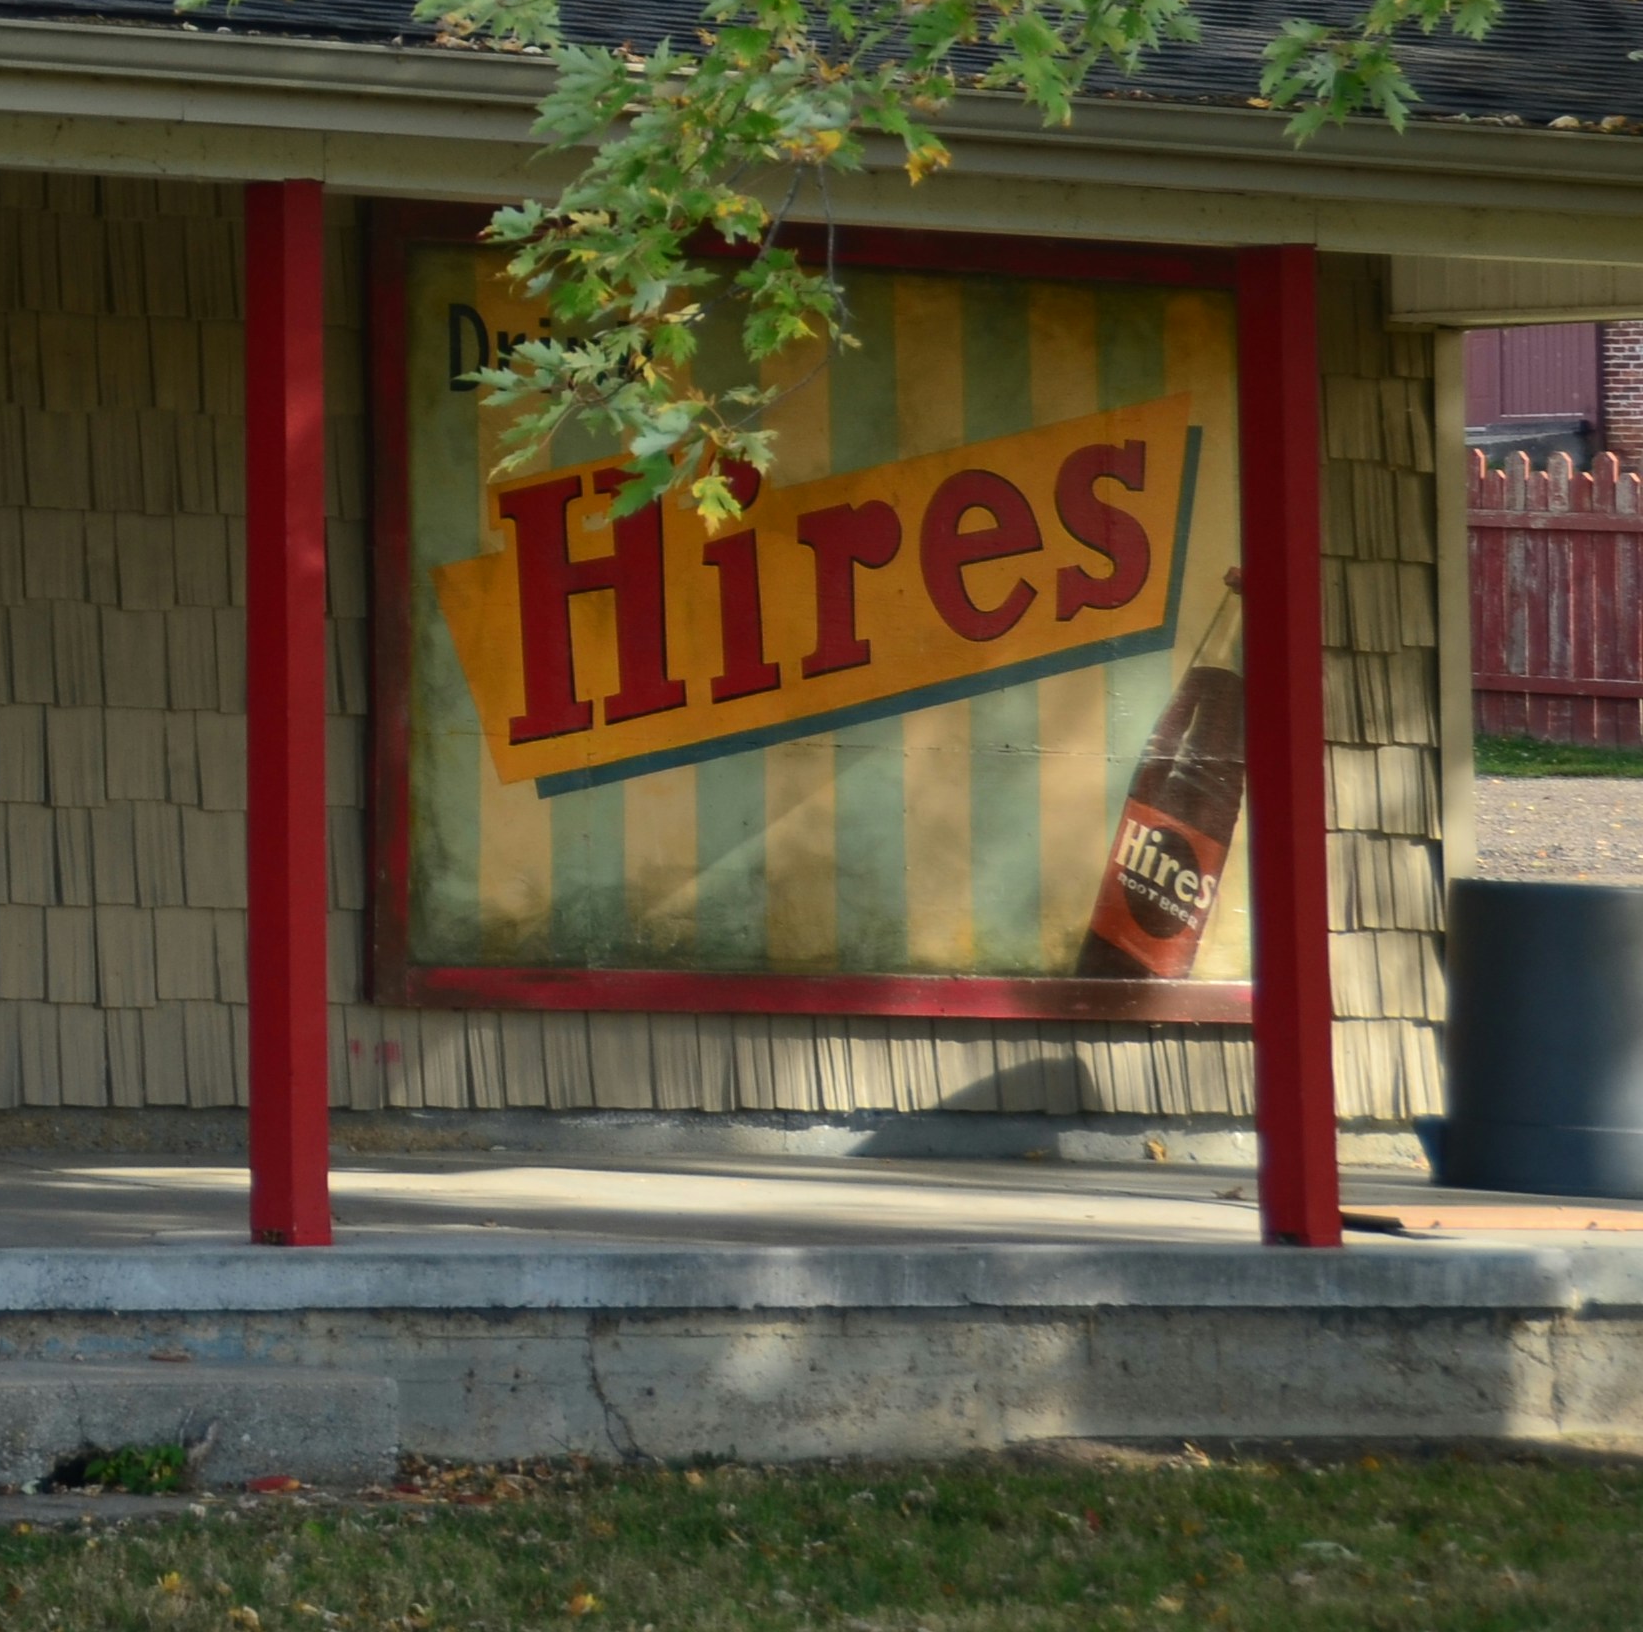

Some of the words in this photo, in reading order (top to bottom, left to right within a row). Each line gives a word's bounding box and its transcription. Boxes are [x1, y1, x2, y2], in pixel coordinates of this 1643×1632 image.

[499, 439, 1151, 746] Hires
[1115, 818, 1216, 909] Hires
[1117, 872, 1159, 901] ROOT
